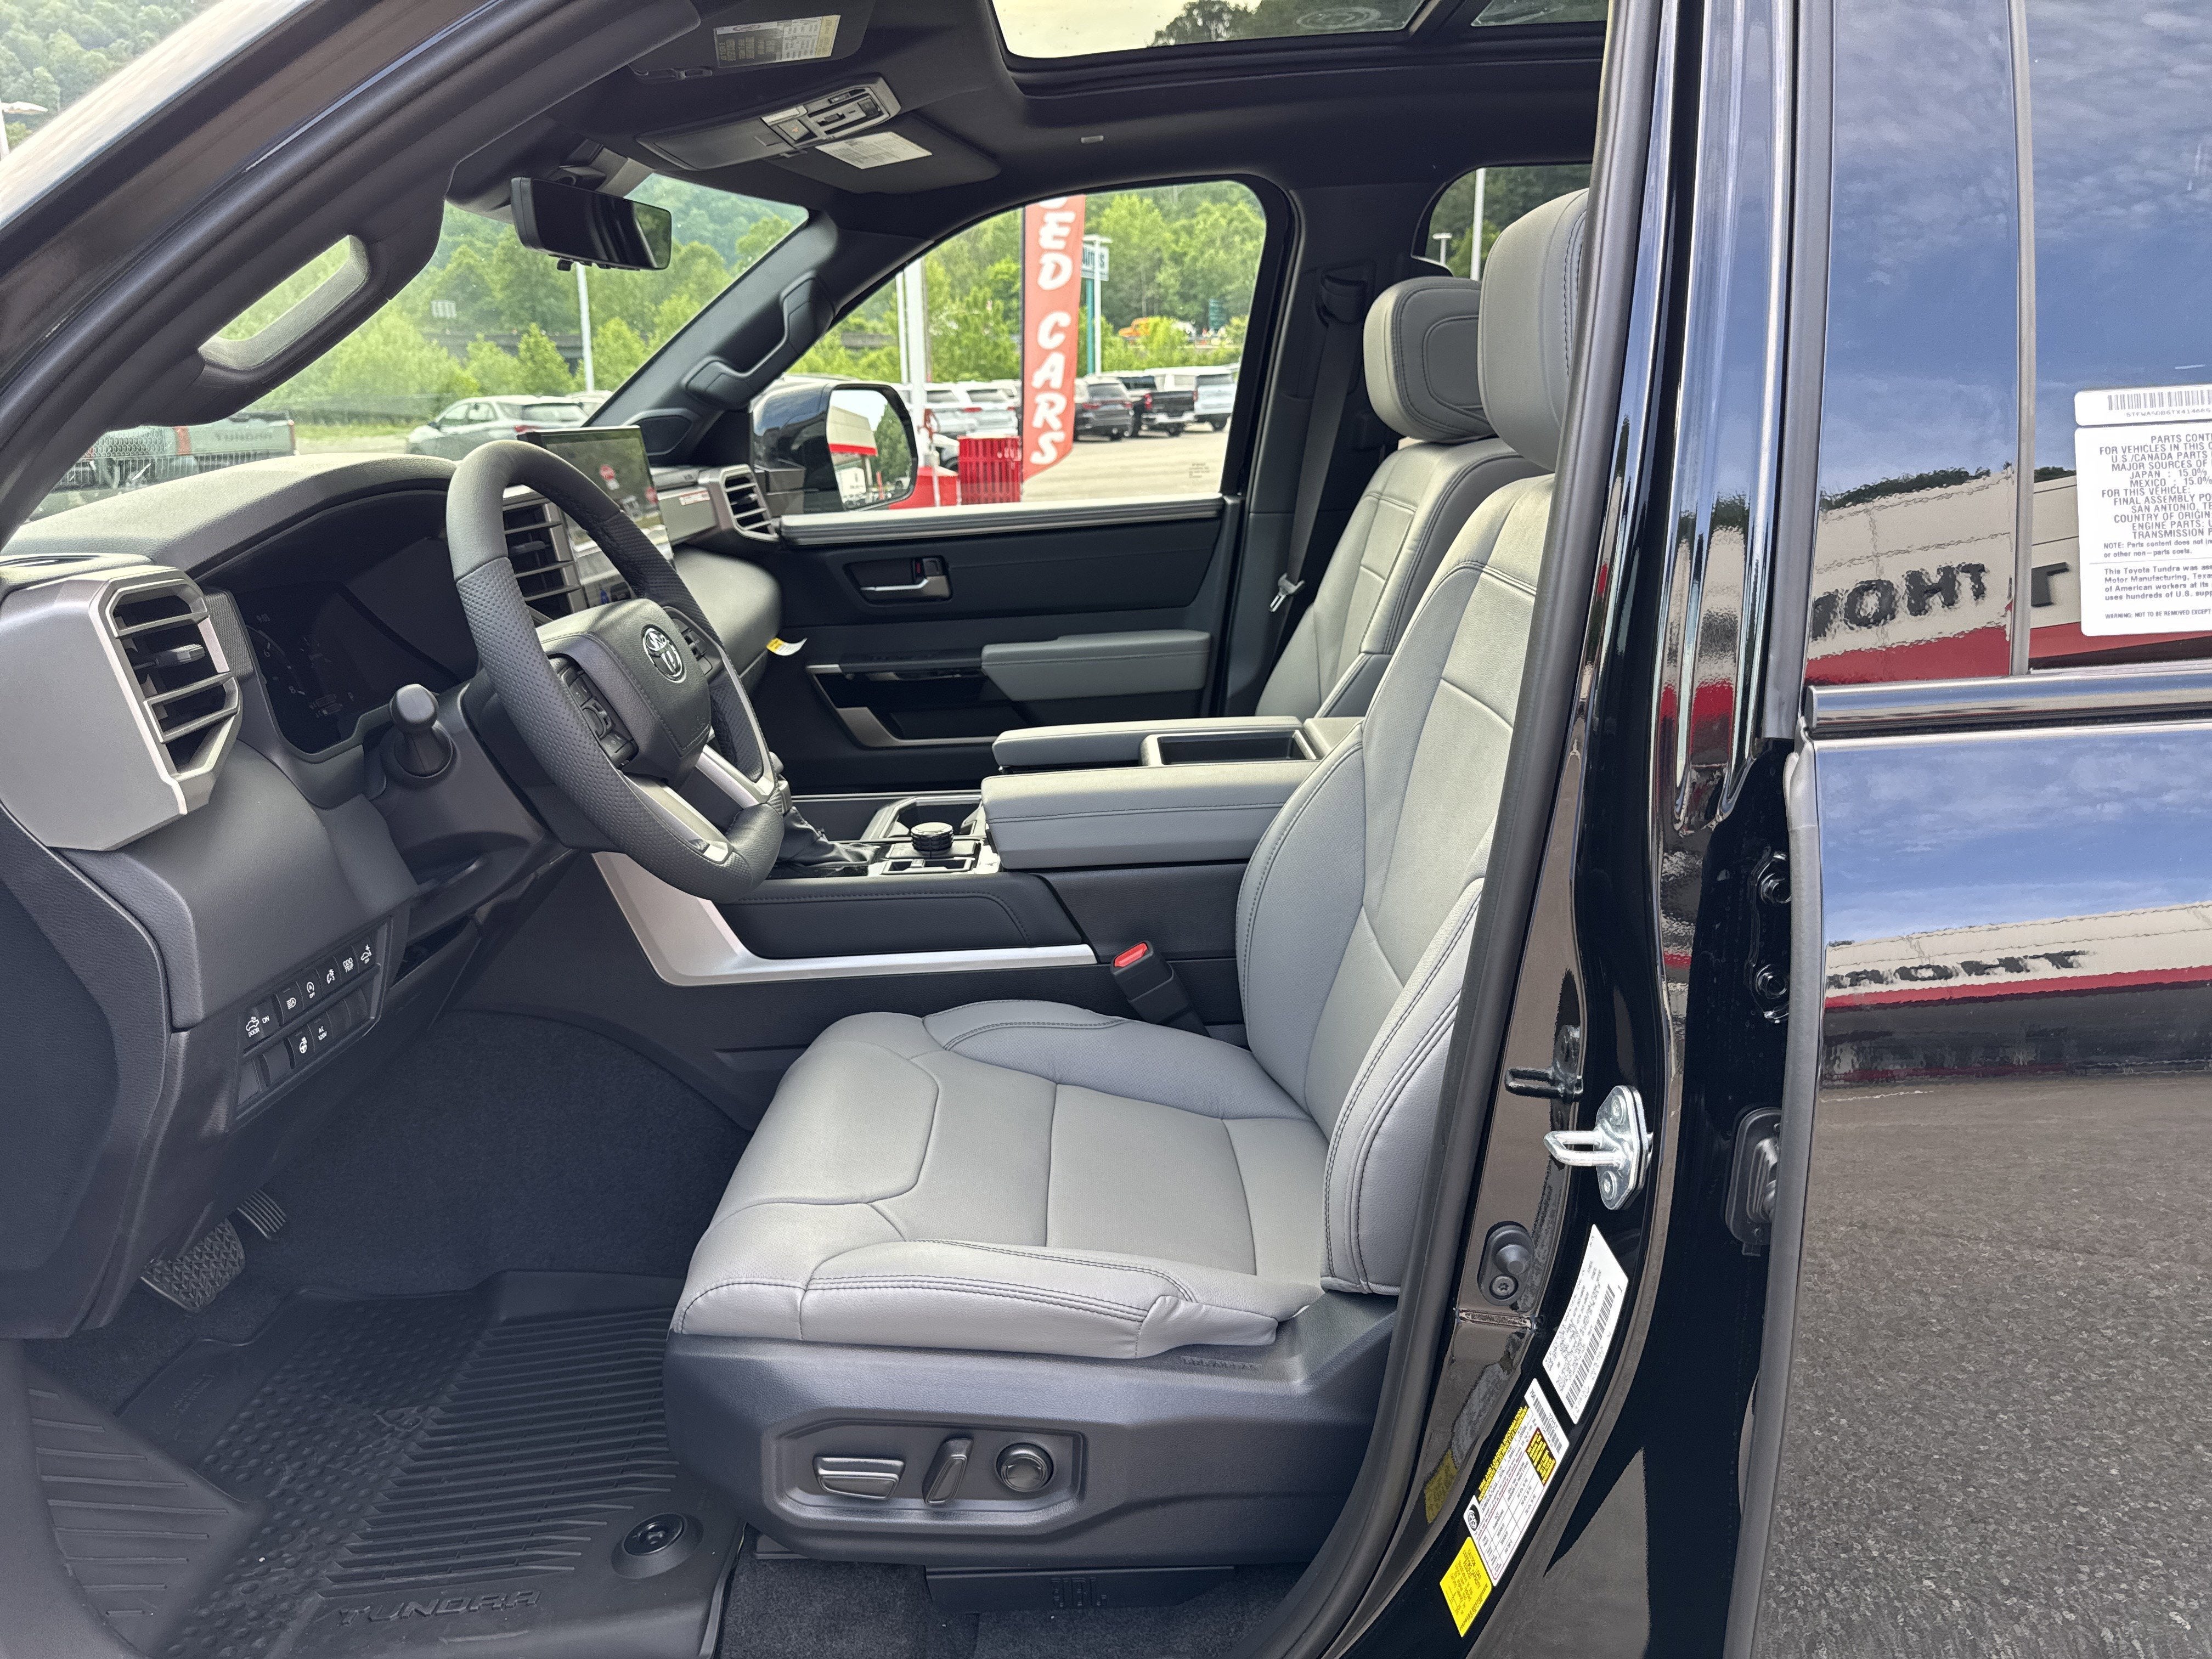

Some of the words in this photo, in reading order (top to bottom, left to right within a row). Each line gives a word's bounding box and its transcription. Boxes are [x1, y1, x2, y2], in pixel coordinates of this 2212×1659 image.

[1037, 196, 1075, 290] ED
[1031, 311, 1071, 465] CARS
[2151, 435, 2182, 444] PARTS
[2100, 447, 2118, 455] FOR
[2121, 444, 2166, 453] VEHICLES
[2183, 442, 2205, 451] THIS
[2177, 451, 2208, 459] PARTS
[2148, 460, 2192, 470] SOURCES
[2196, 459, 2208, 467] OF
[2130, 470, 2160, 479] JAPAN
[2179, 469, 2207, 477] 15.0%
[2130, 478, 2166, 487] MEXICO
[2185, 476, 2212, 485] 15.0%
[2102, 489, 2120, 498] FOR
[2124, 488, 2145, 496] THIS
[2149, 486, 2191, 495] VEHICLE:
[2114, 497, 2141, 505] FINAL
[2145, 494, 2195, 504] ASSEMBLY
[2199, 493, 2212, 501] PO
[2154, 503, 2198, 512] ANTONIO,
[2114, 514, 2159, 523] COUNTRY
[2163, 512, 2174, 521] OF
[2132, 522, 2166, 531] ENGINE
[2171, 520, 2204, 528] PARTS:
[2132, 528, 2204, 539] TRANSMISSION
[343, 958, 353, 967] ODO
[345, 963, 354, 973] TRIP
[262, 1015, 270, 1024] ON
[248, 1027, 261, 1037] DOOR
[338, 1590, 541, 1626] TUNDRA
